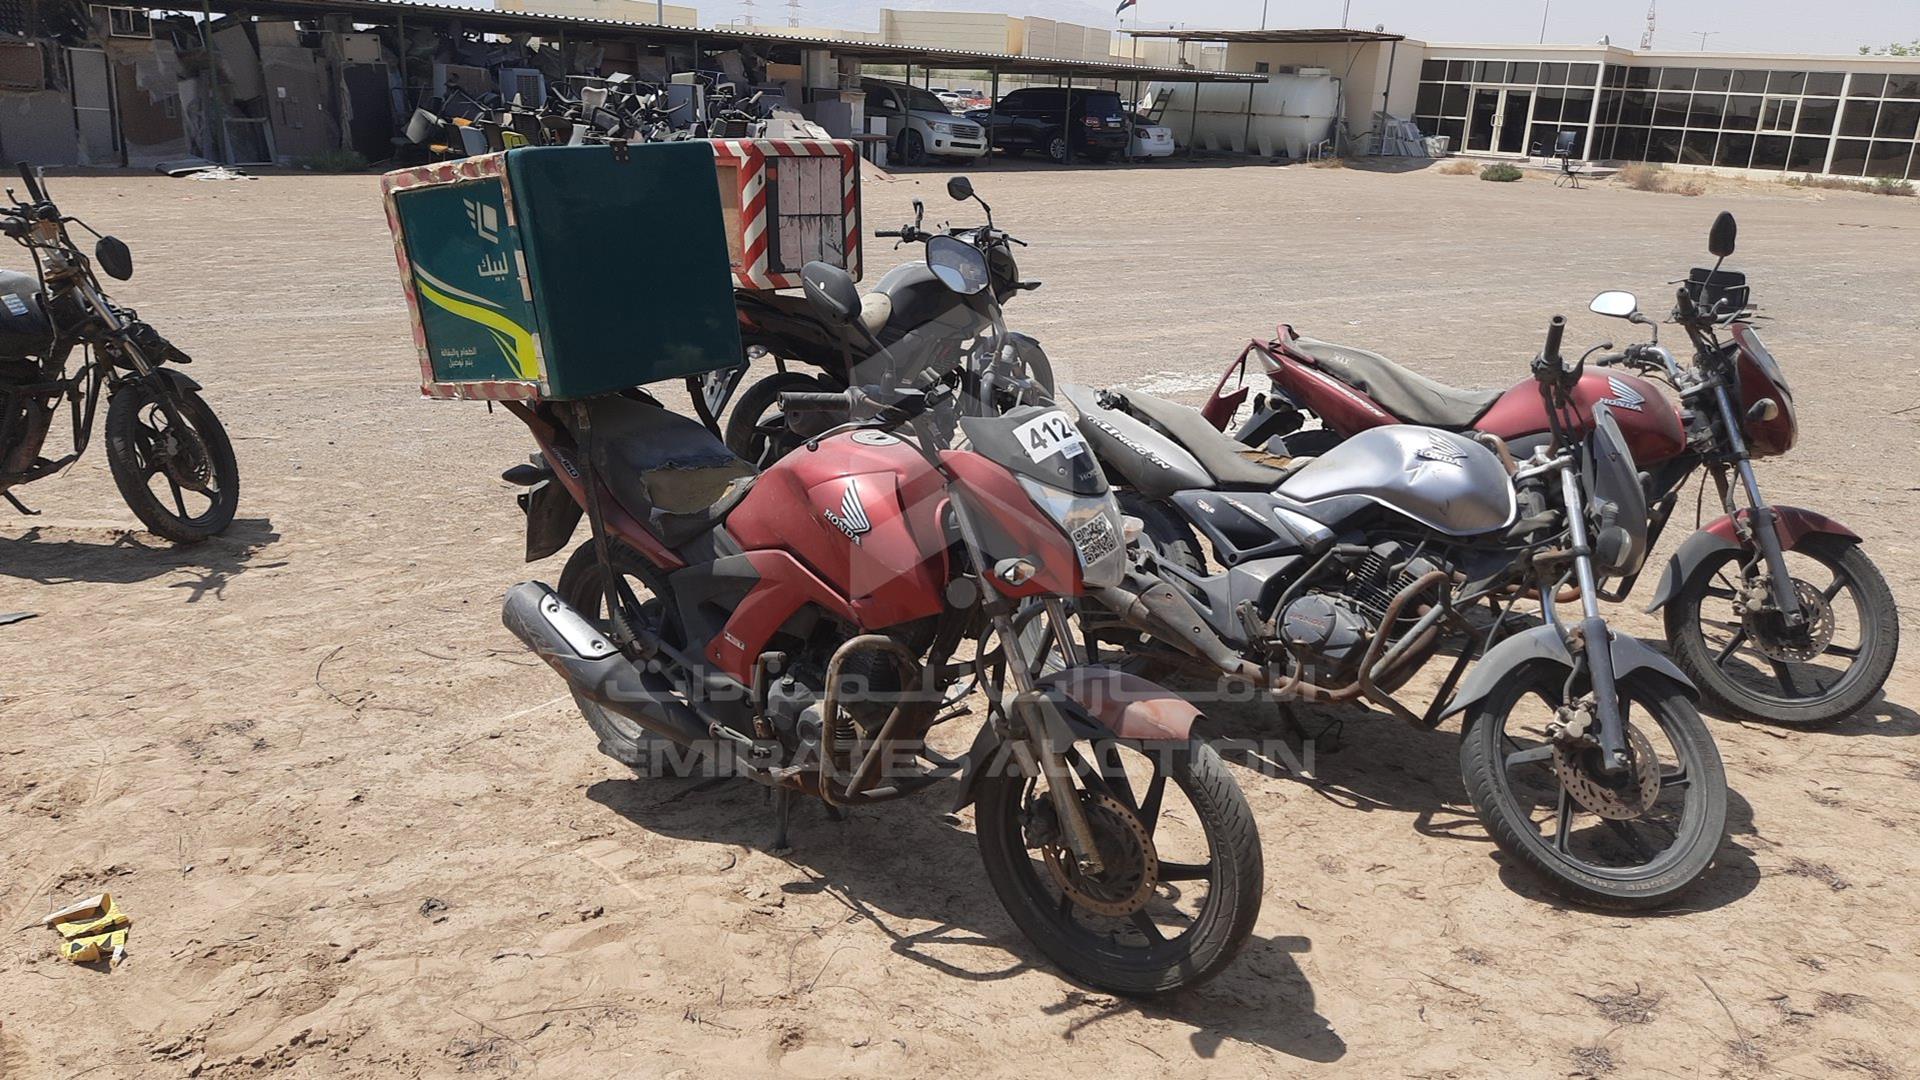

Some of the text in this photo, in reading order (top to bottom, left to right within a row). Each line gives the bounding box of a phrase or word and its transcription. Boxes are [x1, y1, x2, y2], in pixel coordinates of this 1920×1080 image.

[478, 251, 508, 282] لبيك
[1600, 397, 1642, 411] HONDA
[1030, 416, 1079, 450] 412
[823, 508, 861, 546] HONDA
